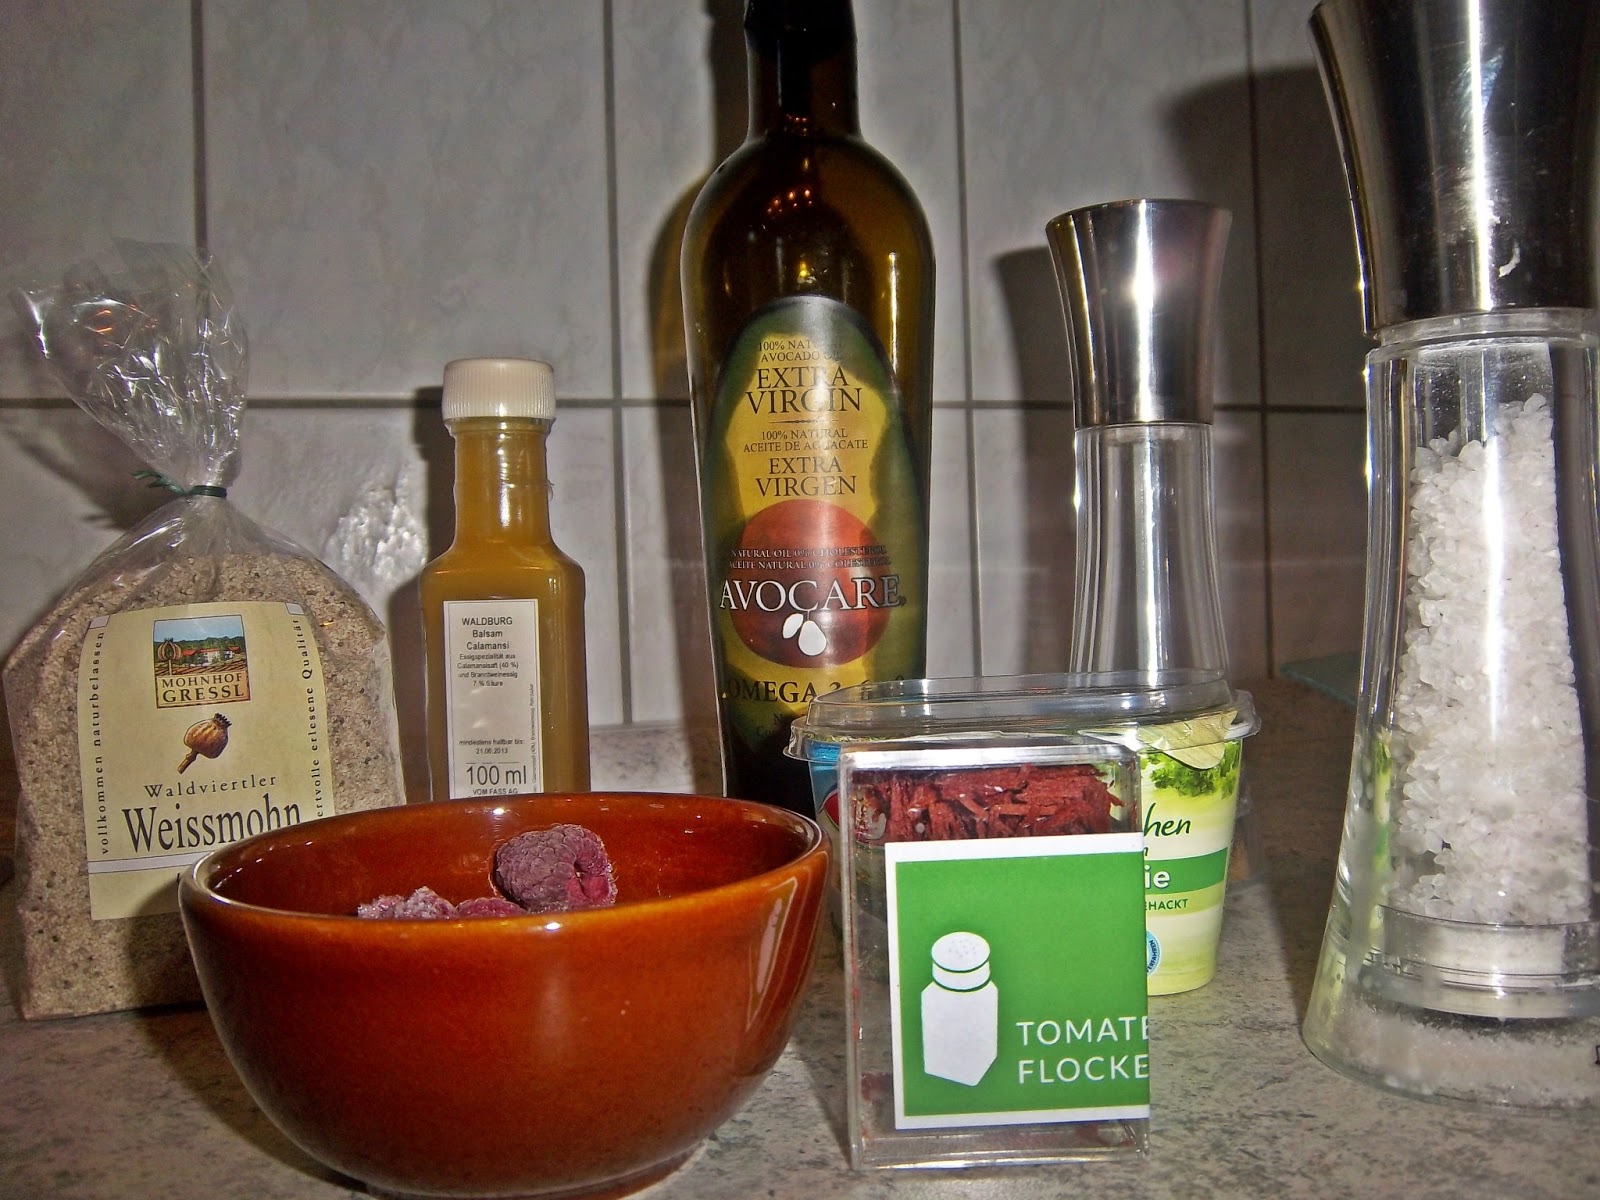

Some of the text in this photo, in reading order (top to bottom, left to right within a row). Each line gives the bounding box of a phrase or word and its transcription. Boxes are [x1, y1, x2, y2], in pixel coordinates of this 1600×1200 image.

[759, 341, 785, 351] 100%
[761, 350, 820, 362] AVOCADO
[756, 366, 849, 389] EXTRA
[745, 388, 862, 414] VIRGIN
[762, 431, 788, 440] 100%
[743, 440, 782, 453] ACEITE
[784, 441, 801, 451] DE
[768, 457, 843, 475] EXTRA
[755, 475, 857, 497] VIRGEN
[773, 549, 793, 558] OIL
[720, 574, 901, 612] AVOCARE
[462, 616, 513, 626] WALDBURG
[472, 630, 503, 638] Balsam
[293, 618, 314, 680] Qualität
[466, 642, 510, 650] Calamansi
[162, 673, 243, 688] MOHNHOF
[162, 686, 245, 703] GRESSL
[727, 680, 818, 704] OMEGA
[307, 687, 320, 751] erlesene
[89, 631, 108, 854] vollkommen naturbelassen
[144, 774, 276, 798] Waldviertler
[466, 765, 527, 786] 100 ml
[121, 793, 301, 853] Weissmohn
[1016, 1015, 1149, 1046] TOMATE
[1018, 1053, 1150, 1084] FLOCKE
